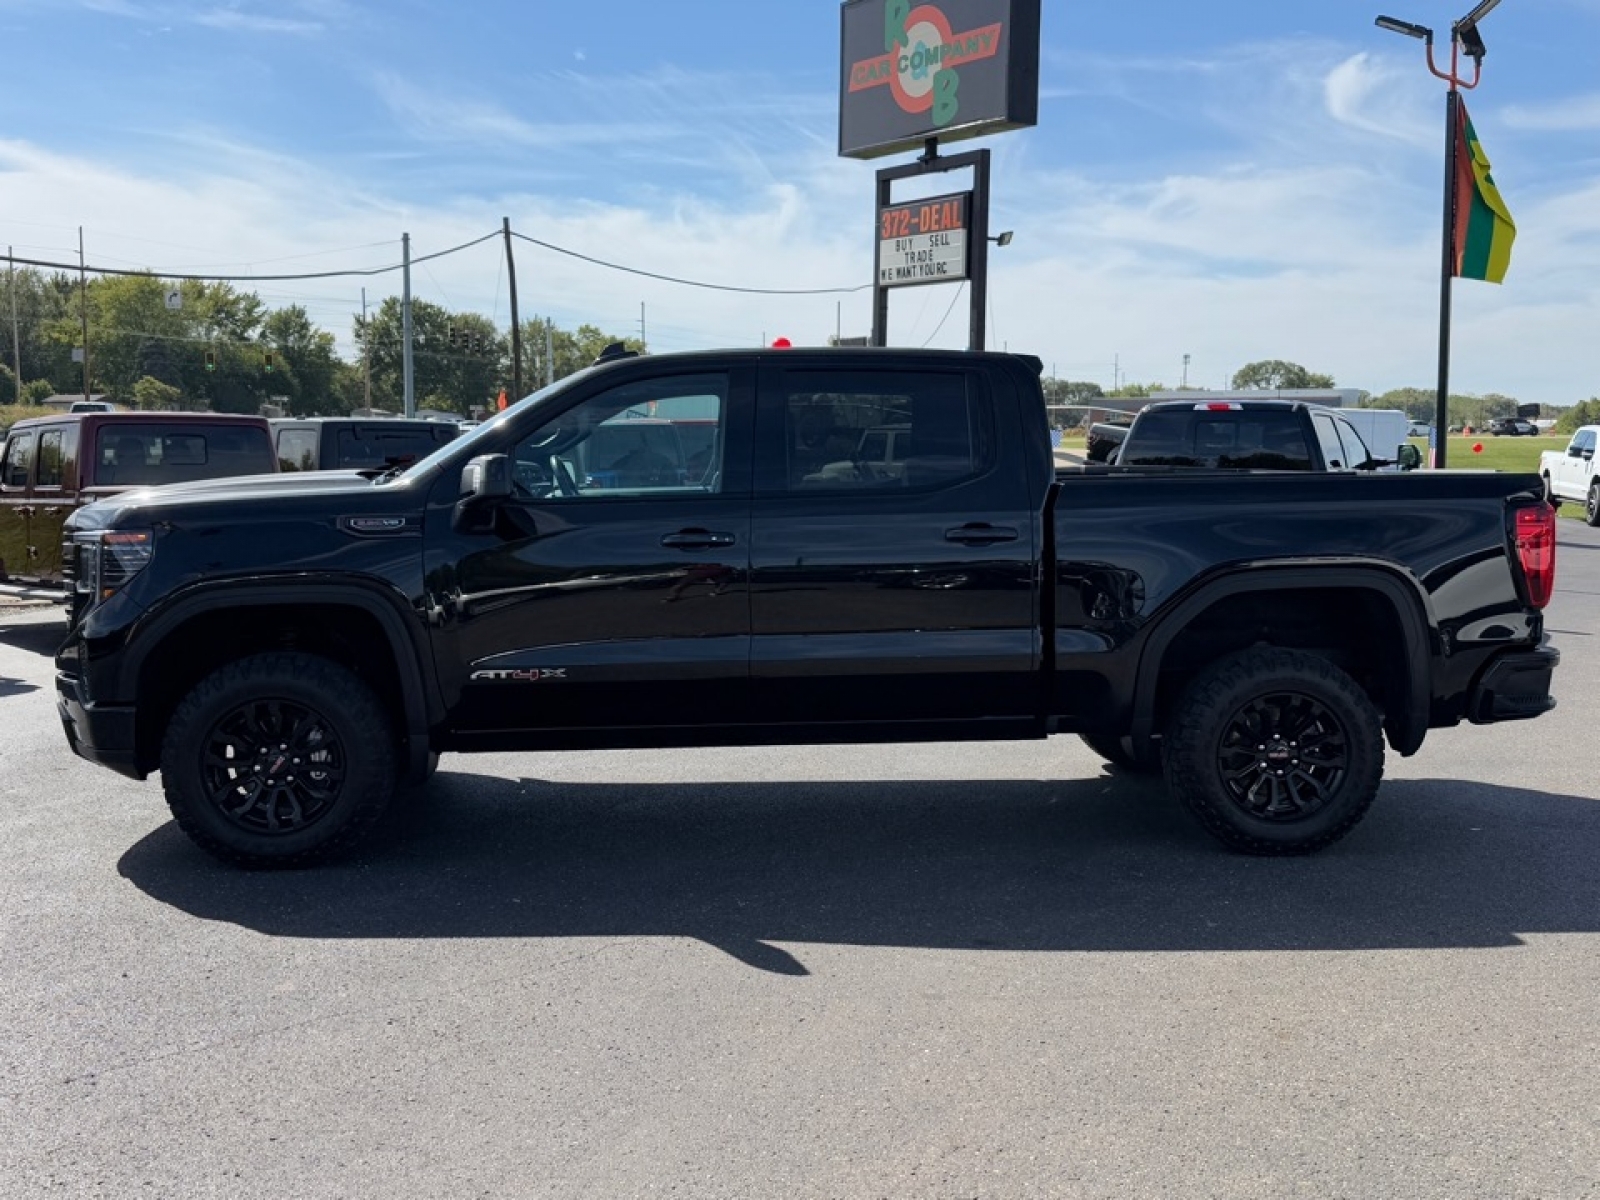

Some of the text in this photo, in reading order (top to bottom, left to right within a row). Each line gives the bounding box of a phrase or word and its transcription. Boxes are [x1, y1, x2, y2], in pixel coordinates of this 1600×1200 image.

[885, 0, 911, 51] R
[854, 33, 993, 85] CAR COMPANY
[932, 68, 960, 126] B
[882, 202, 960, 239] 372-DEAL
[895, 233, 950, 252] BUY SELL
[905, 249, 933, 265] TRADE
[881, 268, 893, 280] WE
[896, 265, 917, 279] WANT
[470, 668, 567, 681] AT4X
